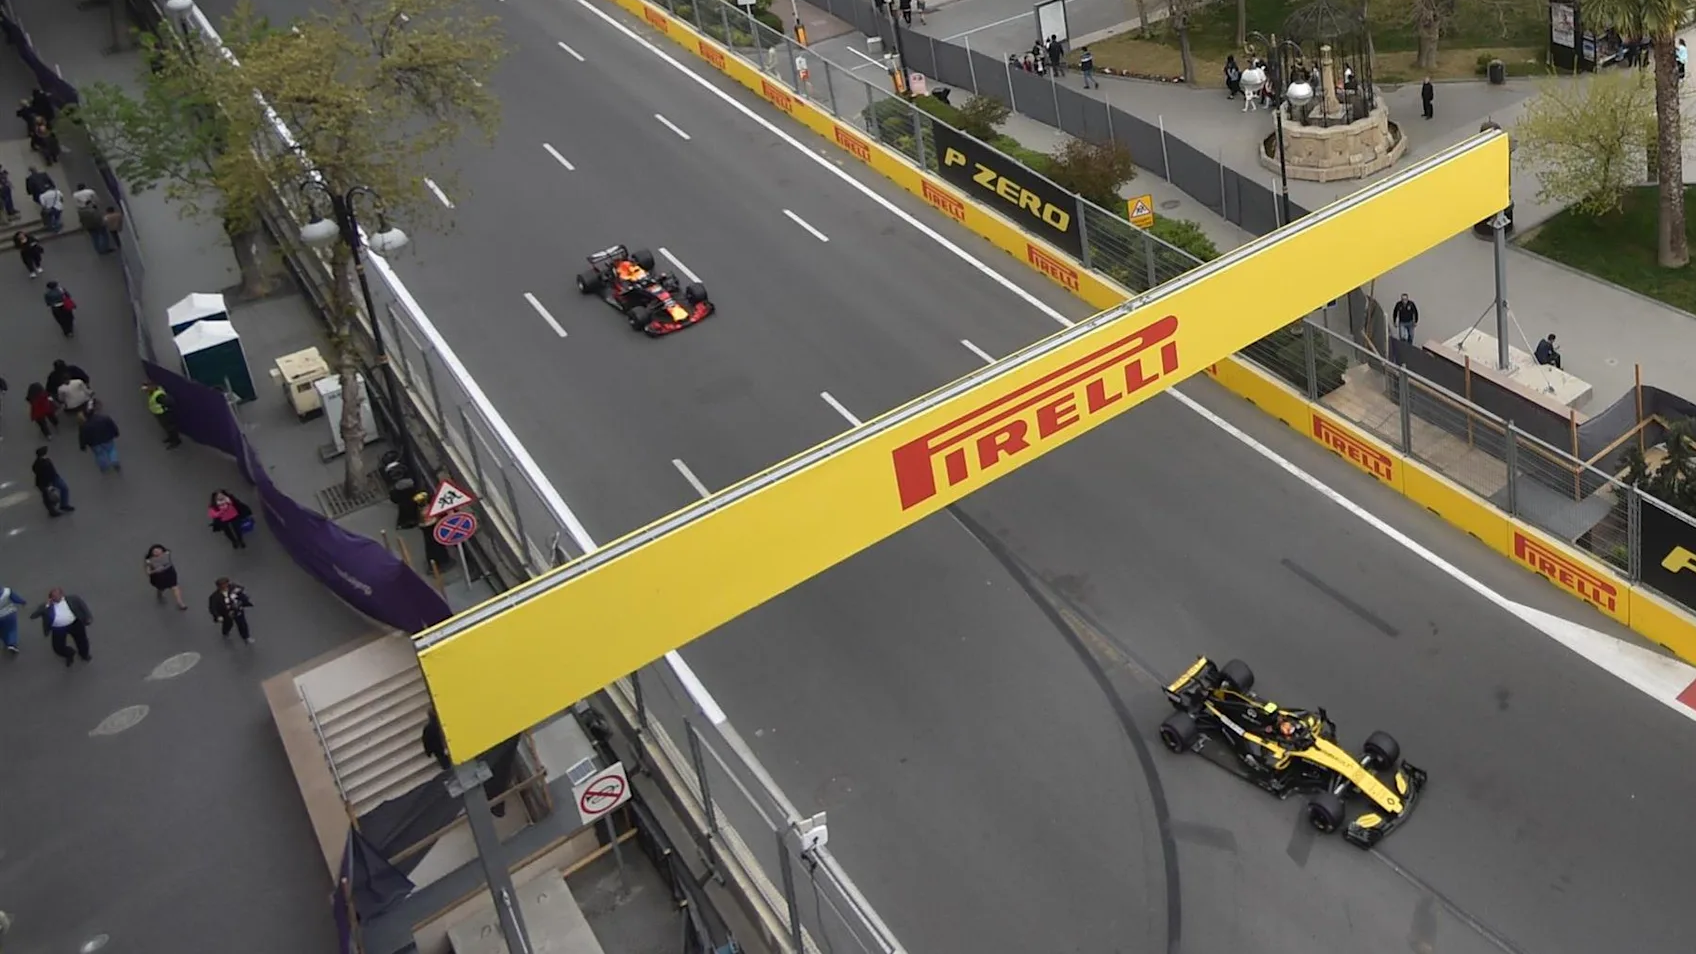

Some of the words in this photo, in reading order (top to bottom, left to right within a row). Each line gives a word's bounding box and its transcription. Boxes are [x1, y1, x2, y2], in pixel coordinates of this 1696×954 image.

[761, 78, 793, 112] PIRELLI
[833, 126, 871, 162] PIRELLI
[922, 179, 965, 221] PIRELLI
[944, 147, 967, 167] P
[973, 162, 1070, 233] ZERO
[1027, 243, 1079, 292] PIRELLI
[892, 315, 1180, 511] PIRELLI
[1313, 414, 1393, 480] PIRELLI
[1514, 530, 1617, 613] PIRELLI
